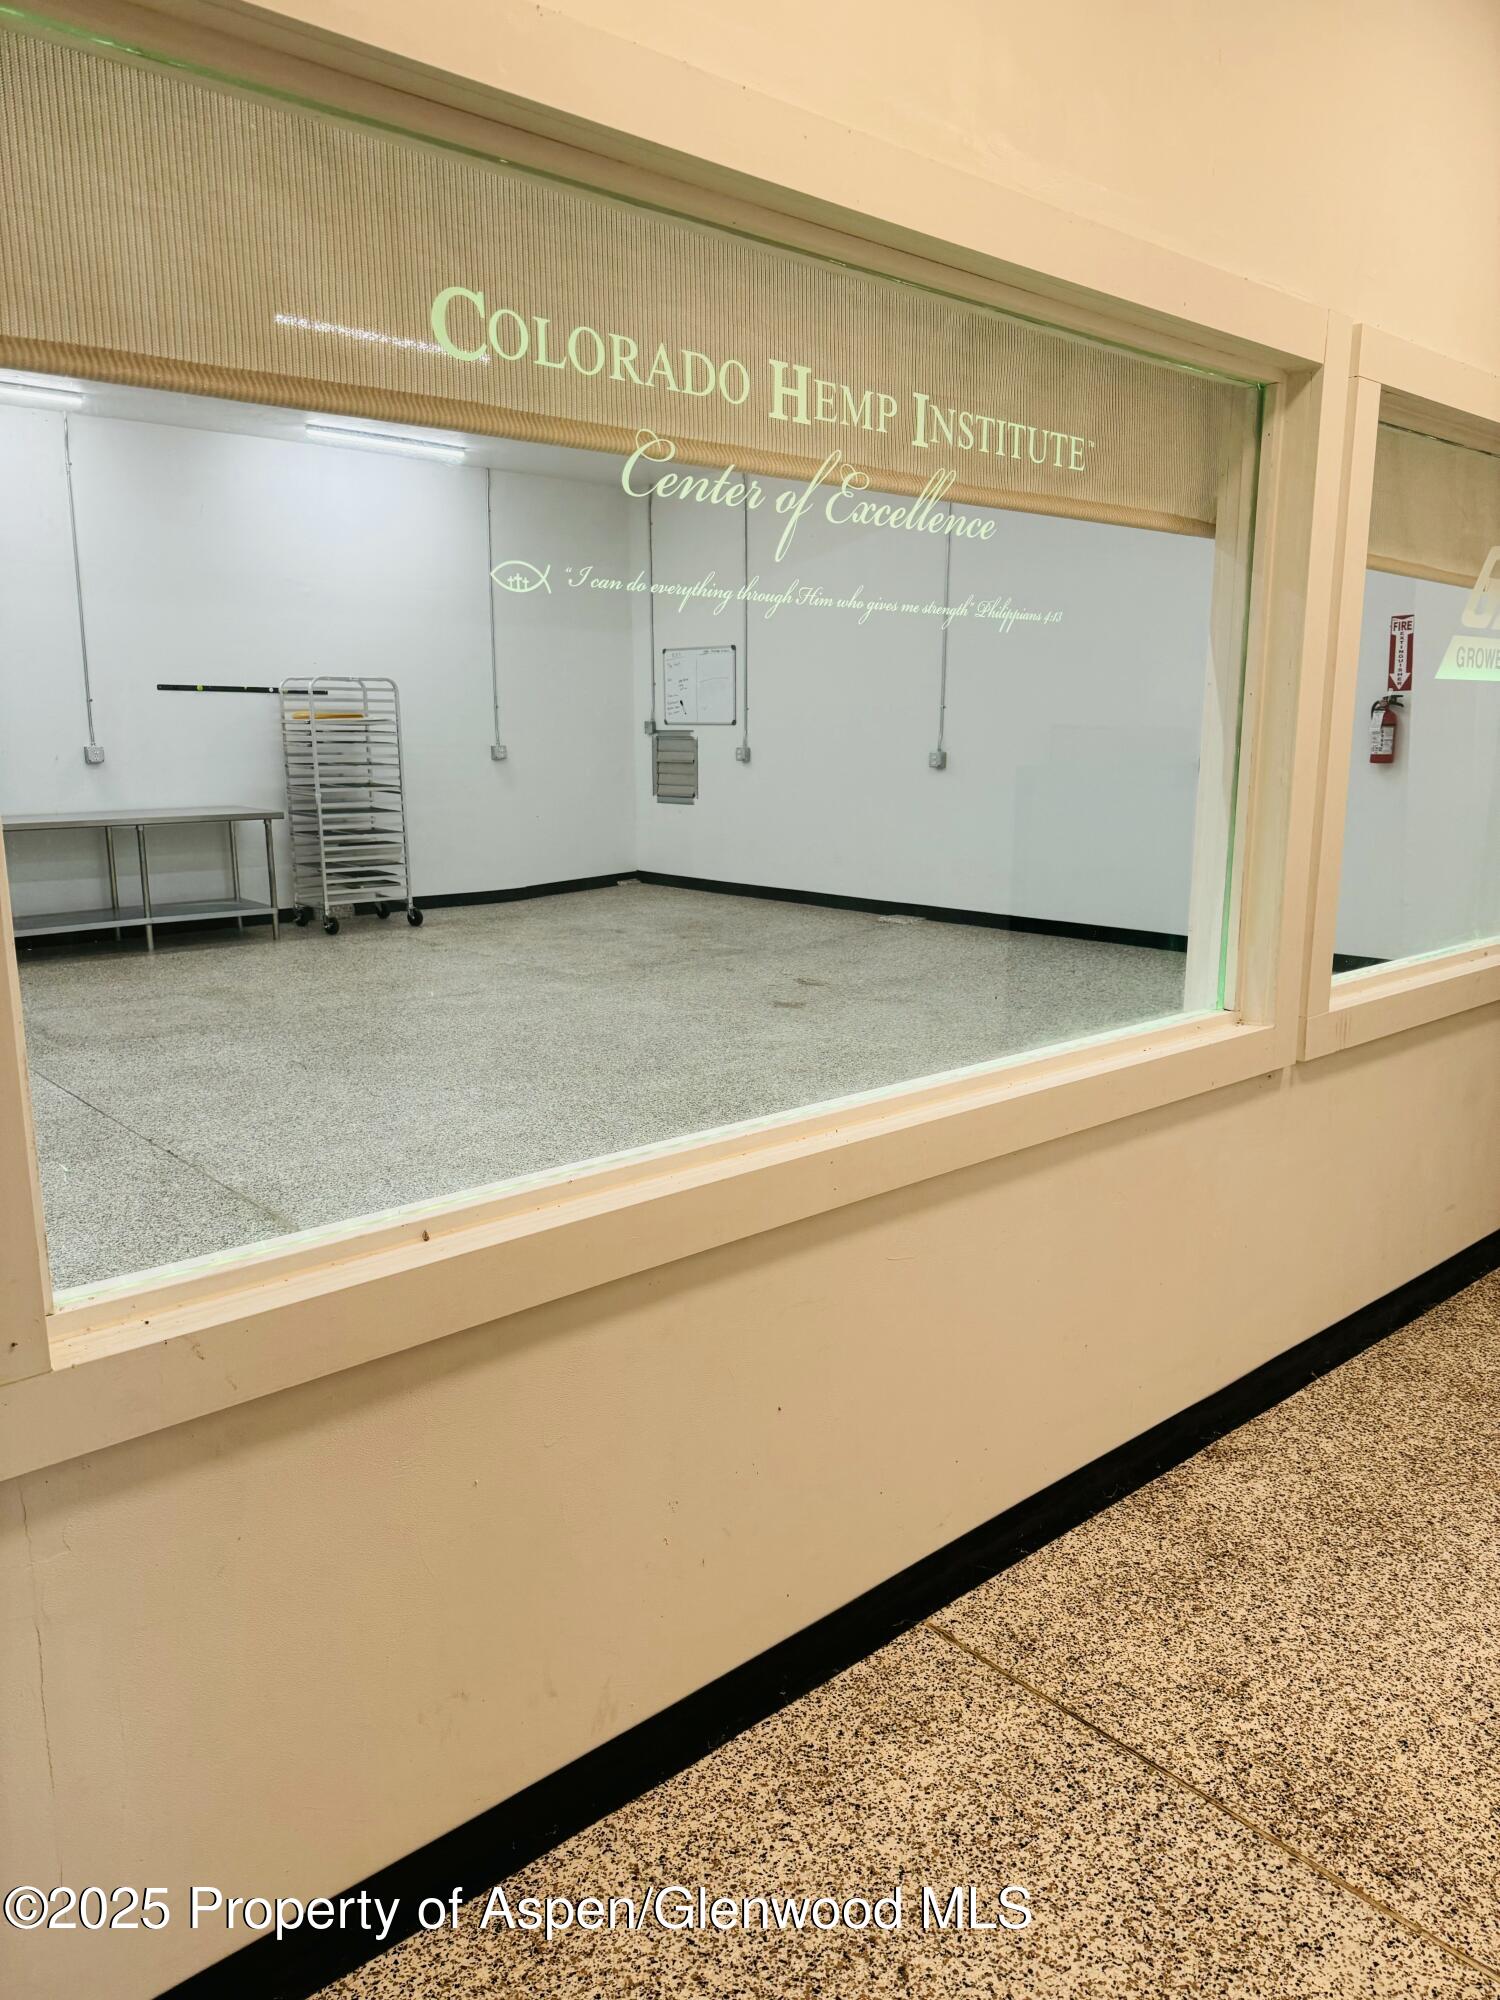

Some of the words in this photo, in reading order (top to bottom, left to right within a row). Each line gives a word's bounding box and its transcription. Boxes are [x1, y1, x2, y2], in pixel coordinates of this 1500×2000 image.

[431, 286, 750, 405] COLORADO
[768, 358, 898, 434] HEMP
[621, 428, 766, 509] Center
[774, 449, 843, 562] of
[825, 463, 998, 541] Excellence
[590, 577, 624, 590] can
[626, 570, 648, 592] do
[650, 570, 735, 616] everything
[736, 575, 801, 619] through
[796, 586, 834, 608] Him
[836, 585, 864, 610] who
[858, 597, 899, 625] gives
[900, 604, 923, 614] me
[974, 597, 1042, 633] Philippians
[1043, 611, 1064, 625] 4:13
[1393, 620, 1413, 632] FIRE
